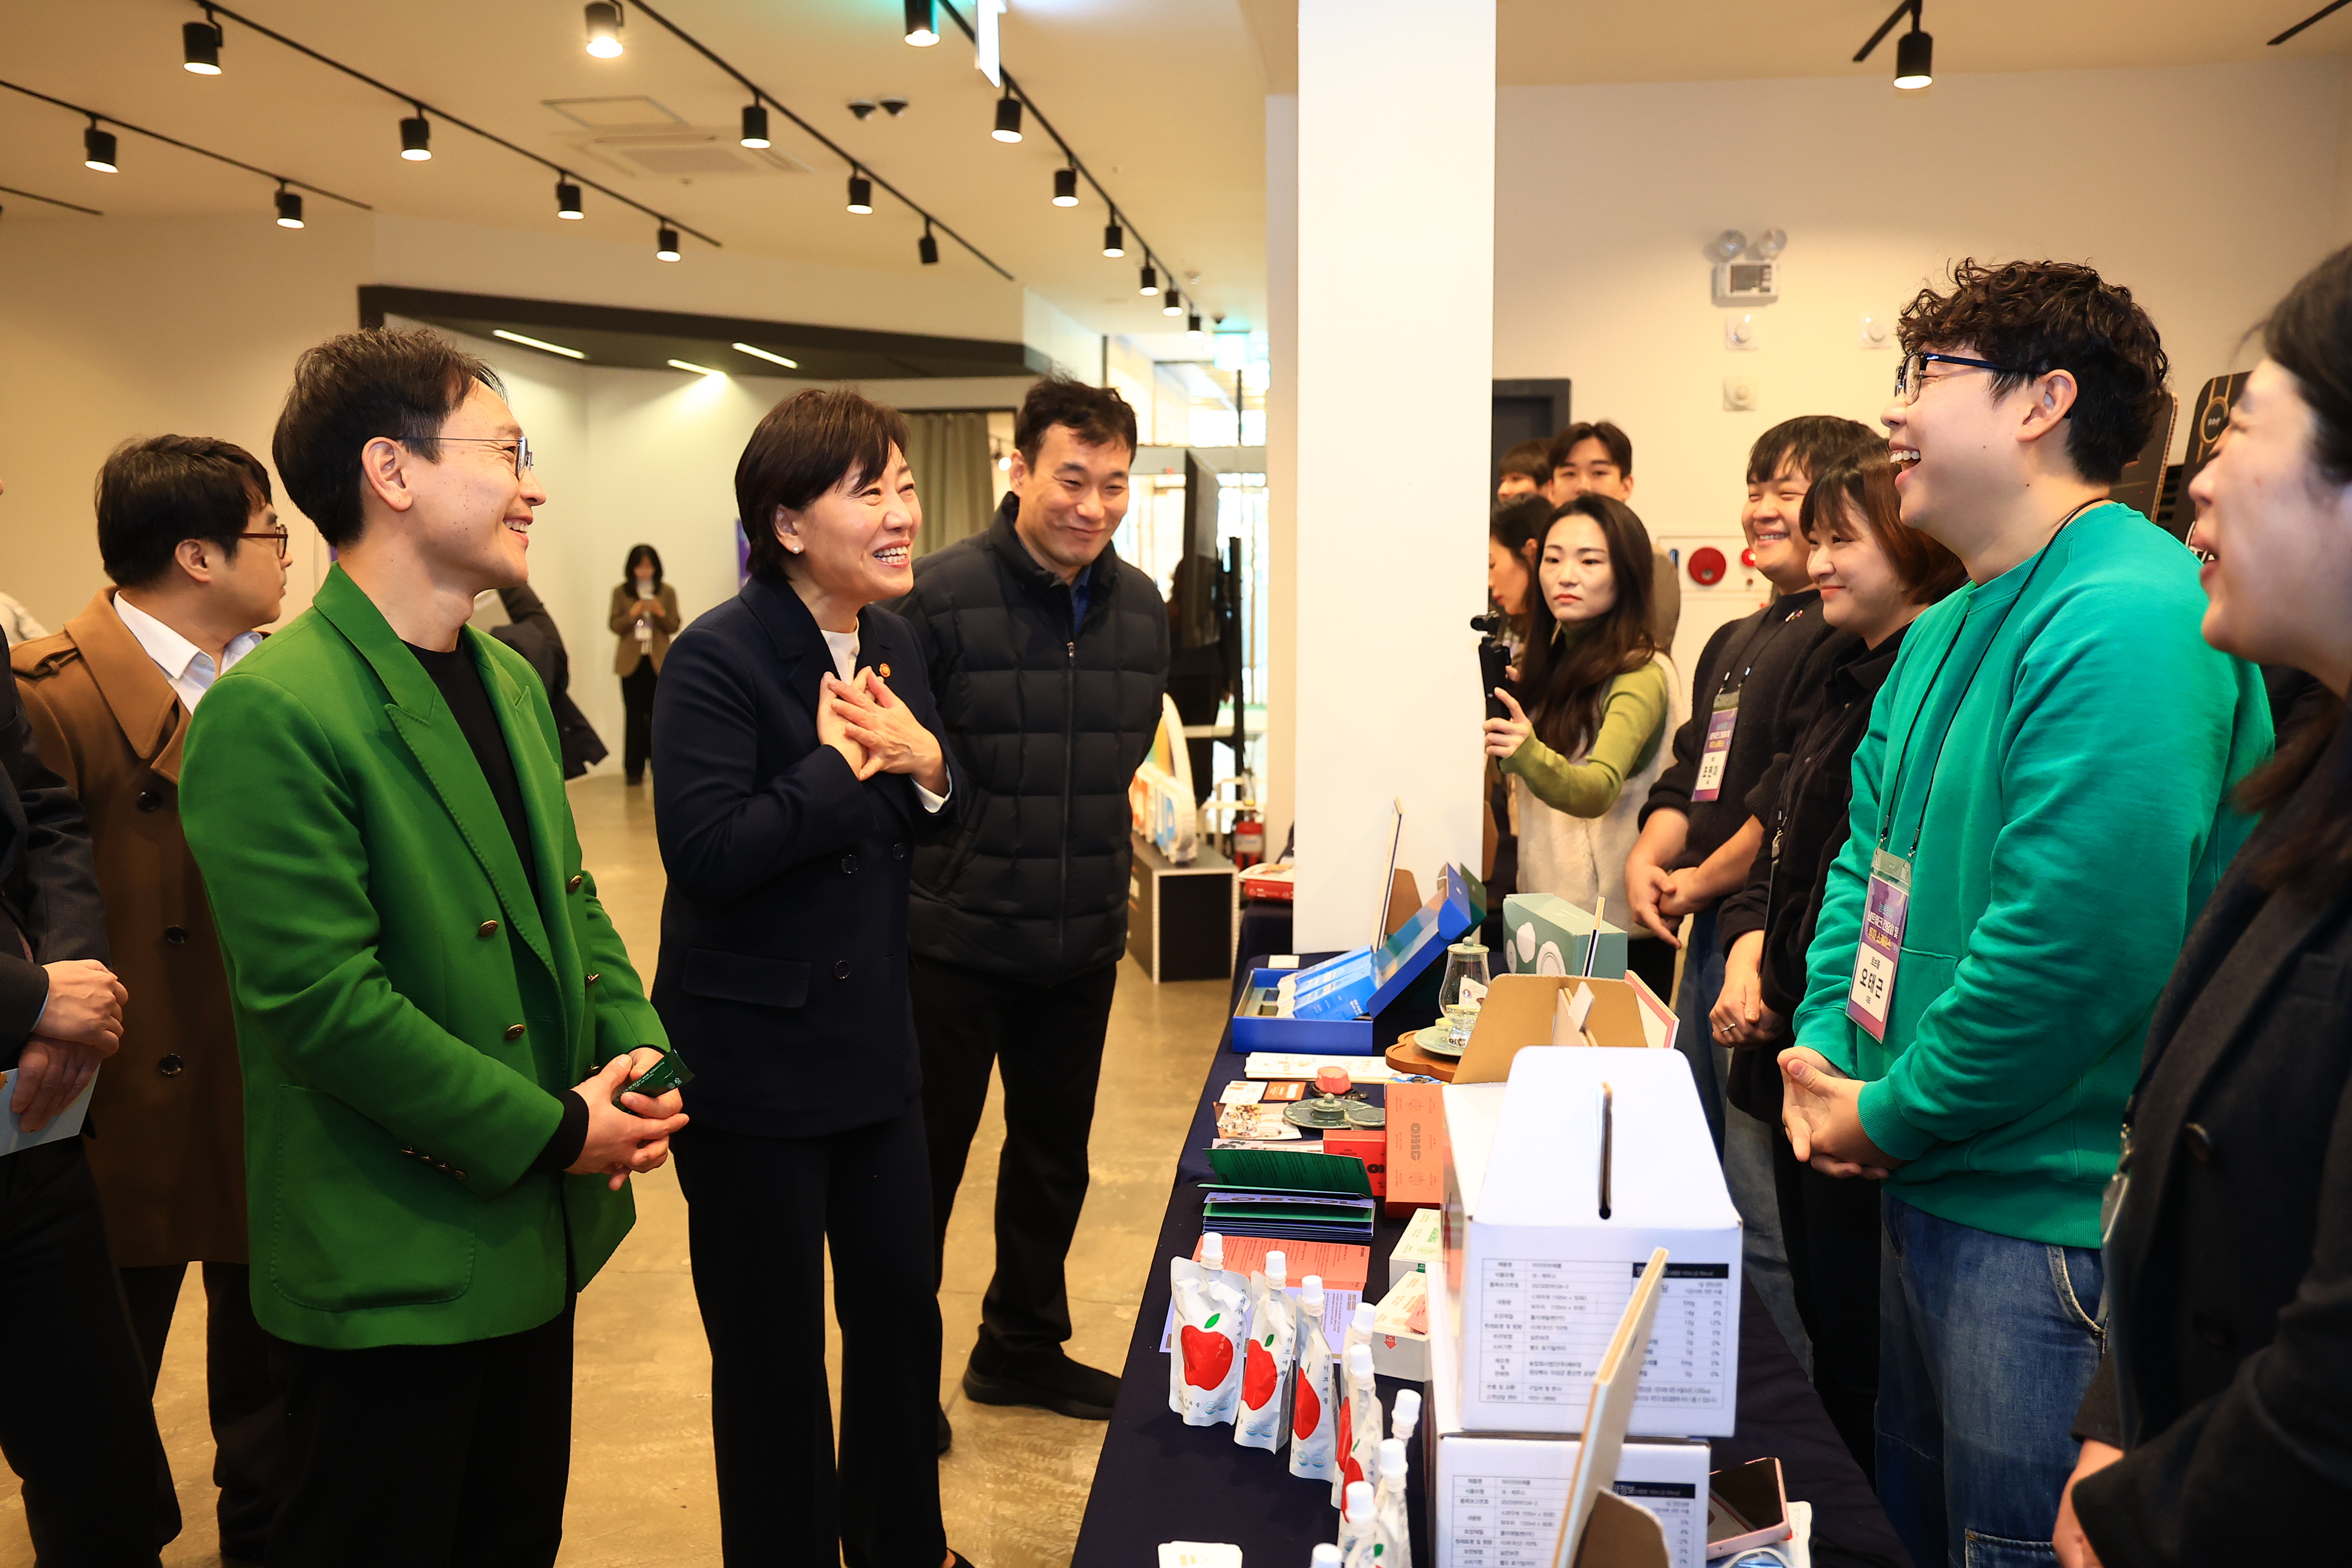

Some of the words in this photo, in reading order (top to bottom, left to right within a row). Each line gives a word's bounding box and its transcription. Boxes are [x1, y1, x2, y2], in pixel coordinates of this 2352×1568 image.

[1867, 910, 1883, 929] 네트워크
[1893, 926, 1899, 939] 및
[1860, 968, 1884, 999] 오태근
